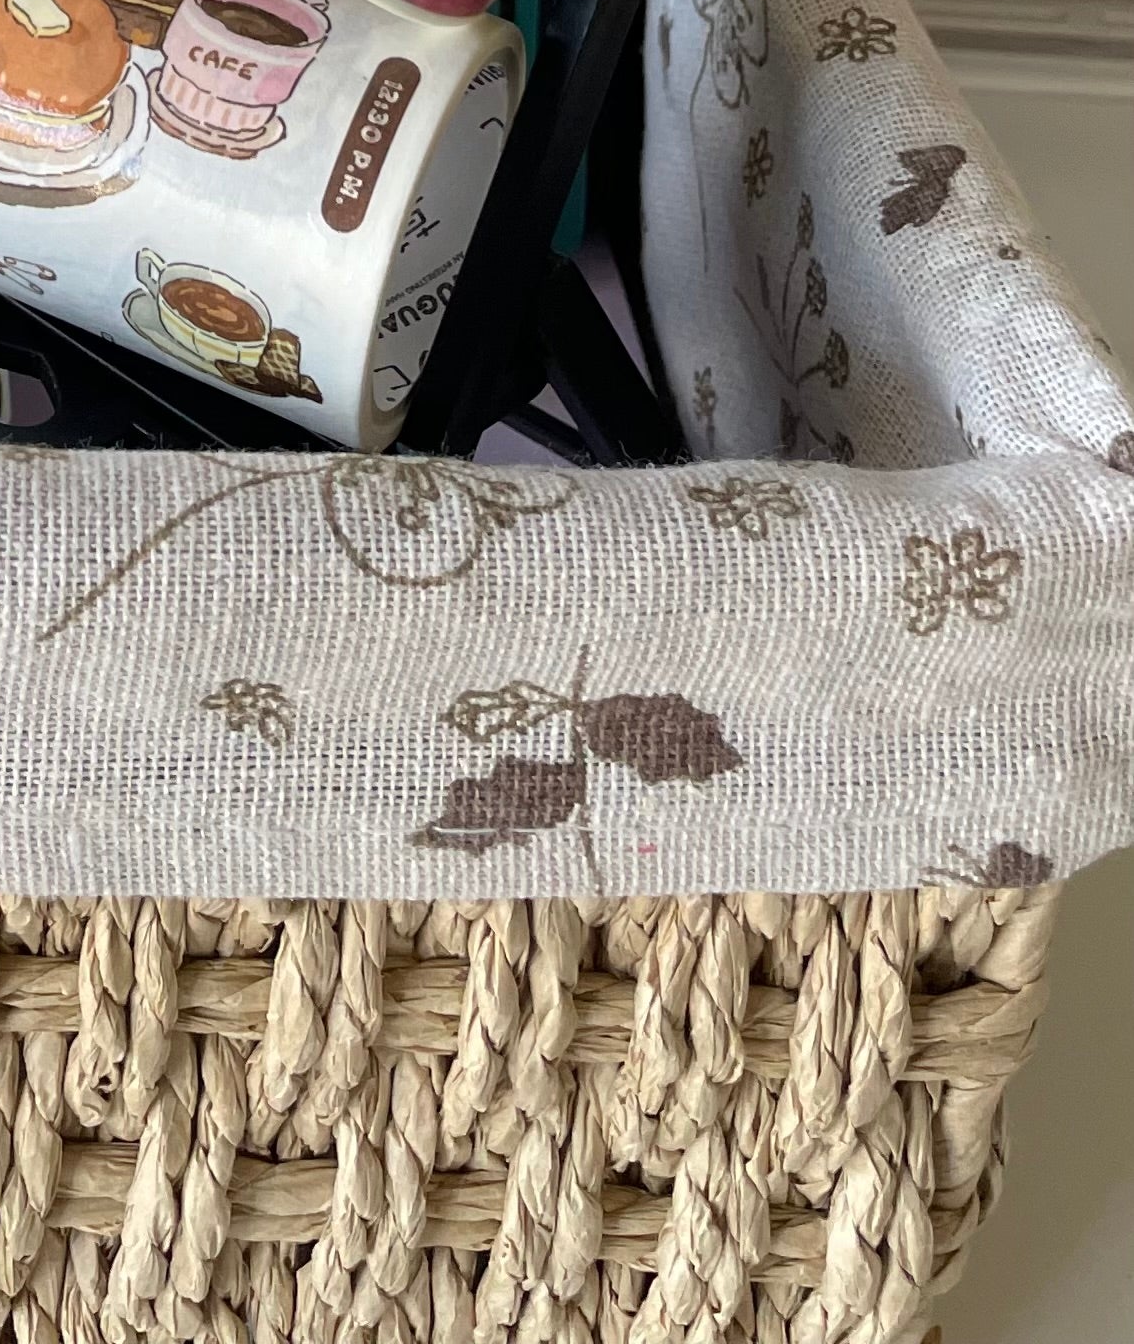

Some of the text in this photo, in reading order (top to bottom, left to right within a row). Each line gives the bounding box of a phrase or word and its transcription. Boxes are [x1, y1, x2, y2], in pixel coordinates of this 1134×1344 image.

[188, 45, 259, 82] CAFE
[334, 78, 404, 205] 12:30 P.M.
[377, 273, 458, 340] UGUA
